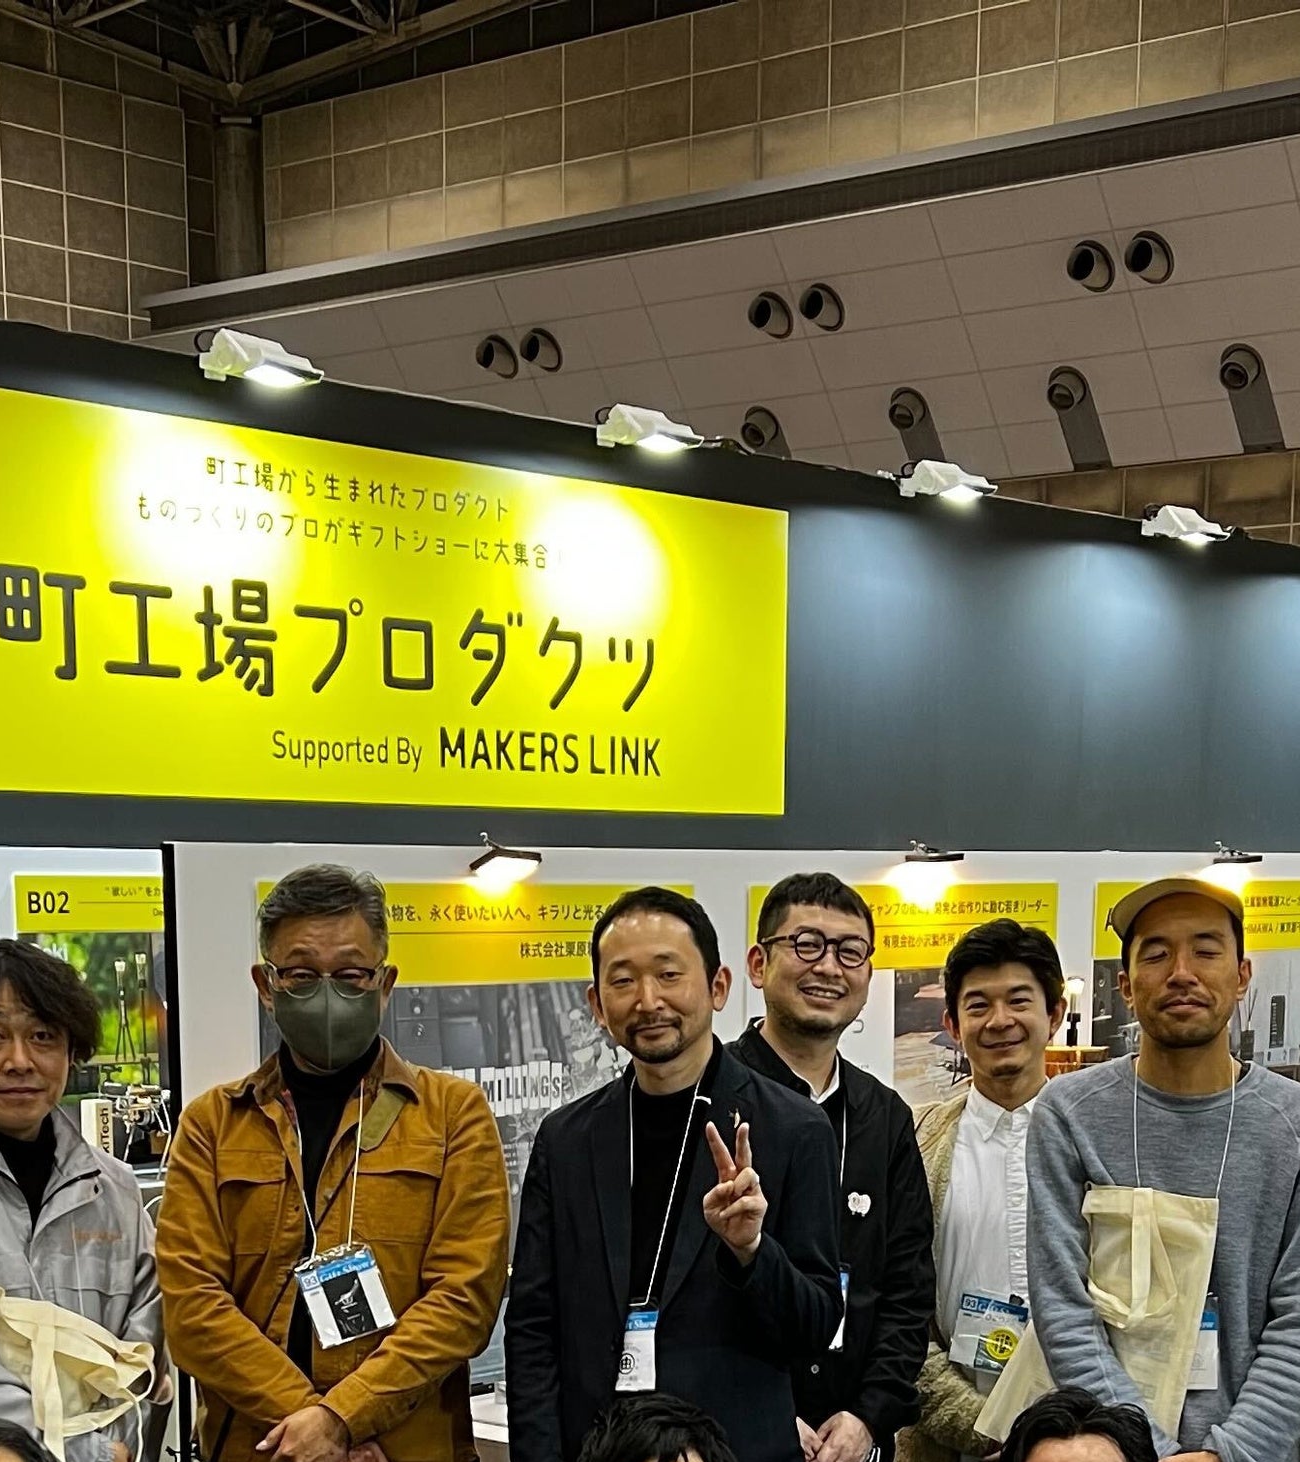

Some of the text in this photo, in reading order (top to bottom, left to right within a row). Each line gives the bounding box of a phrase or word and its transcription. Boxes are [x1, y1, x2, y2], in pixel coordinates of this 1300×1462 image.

[272, 727, 662, 777] Supported By MAKERS LINK
[27, 890, 70, 914] B02
[482, 1075, 561, 1102] MILLINGS
